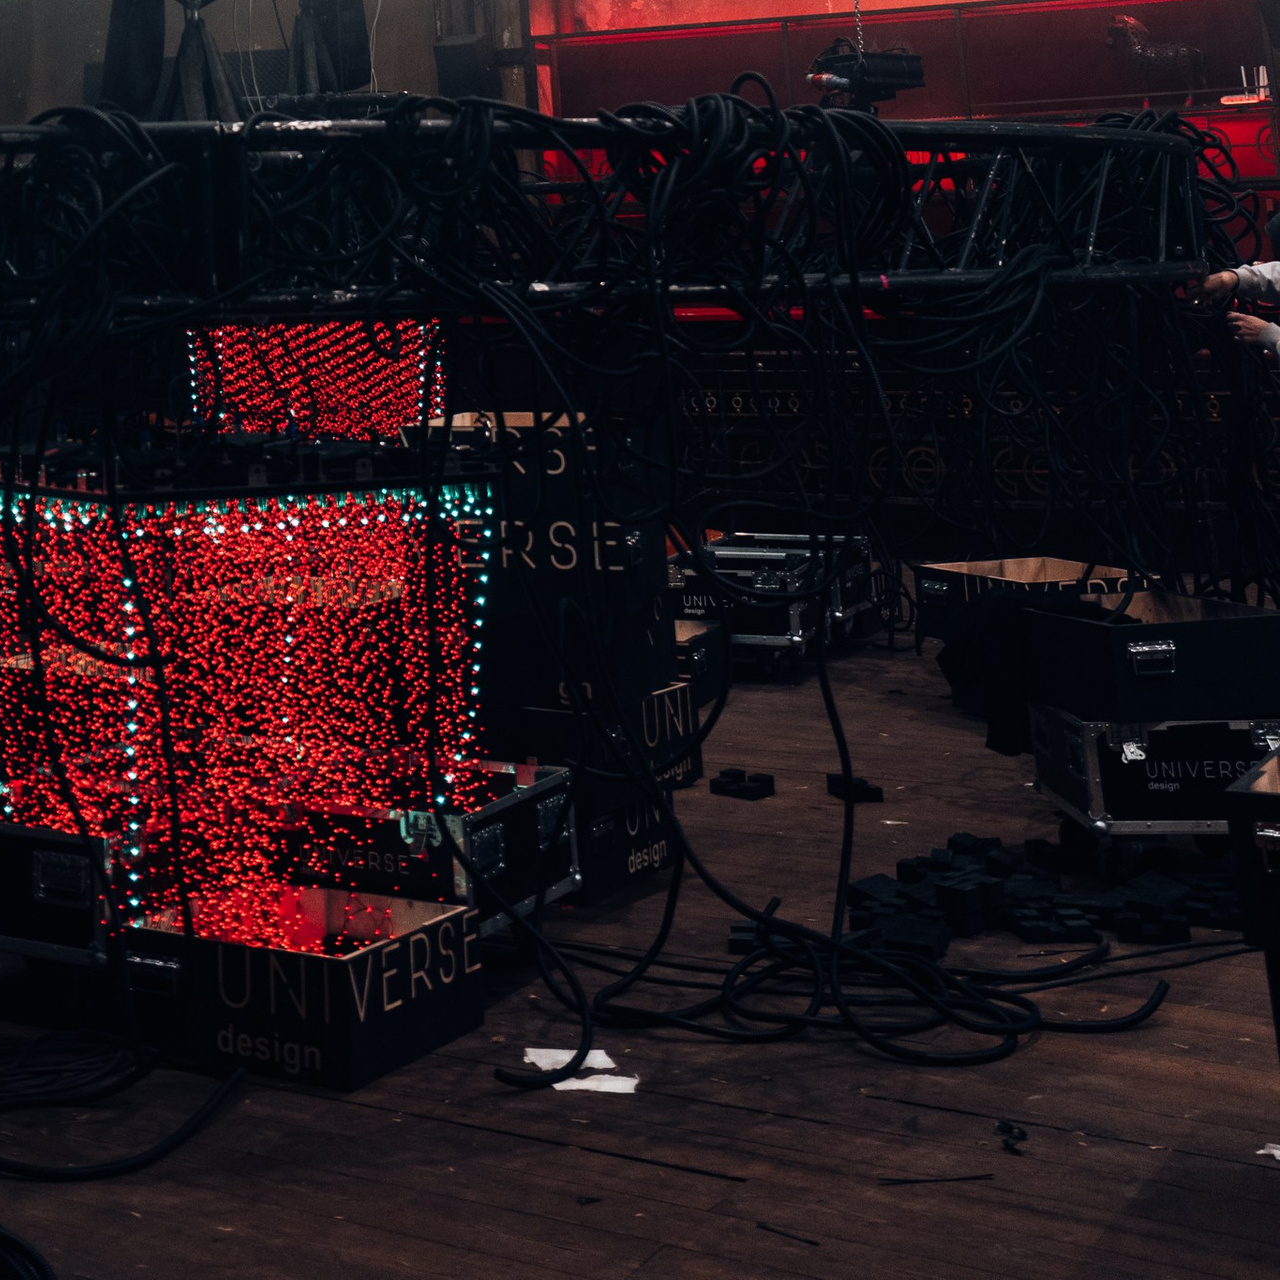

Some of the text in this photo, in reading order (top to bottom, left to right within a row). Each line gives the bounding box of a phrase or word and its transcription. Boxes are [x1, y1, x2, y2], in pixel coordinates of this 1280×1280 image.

[641, 686, 693, 747] UNI
[1147, 780, 1180, 792] design
[625, 791, 667, 837] UN
[627, 839, 668, 875] design
[217, 1022, 322, 1075] design
